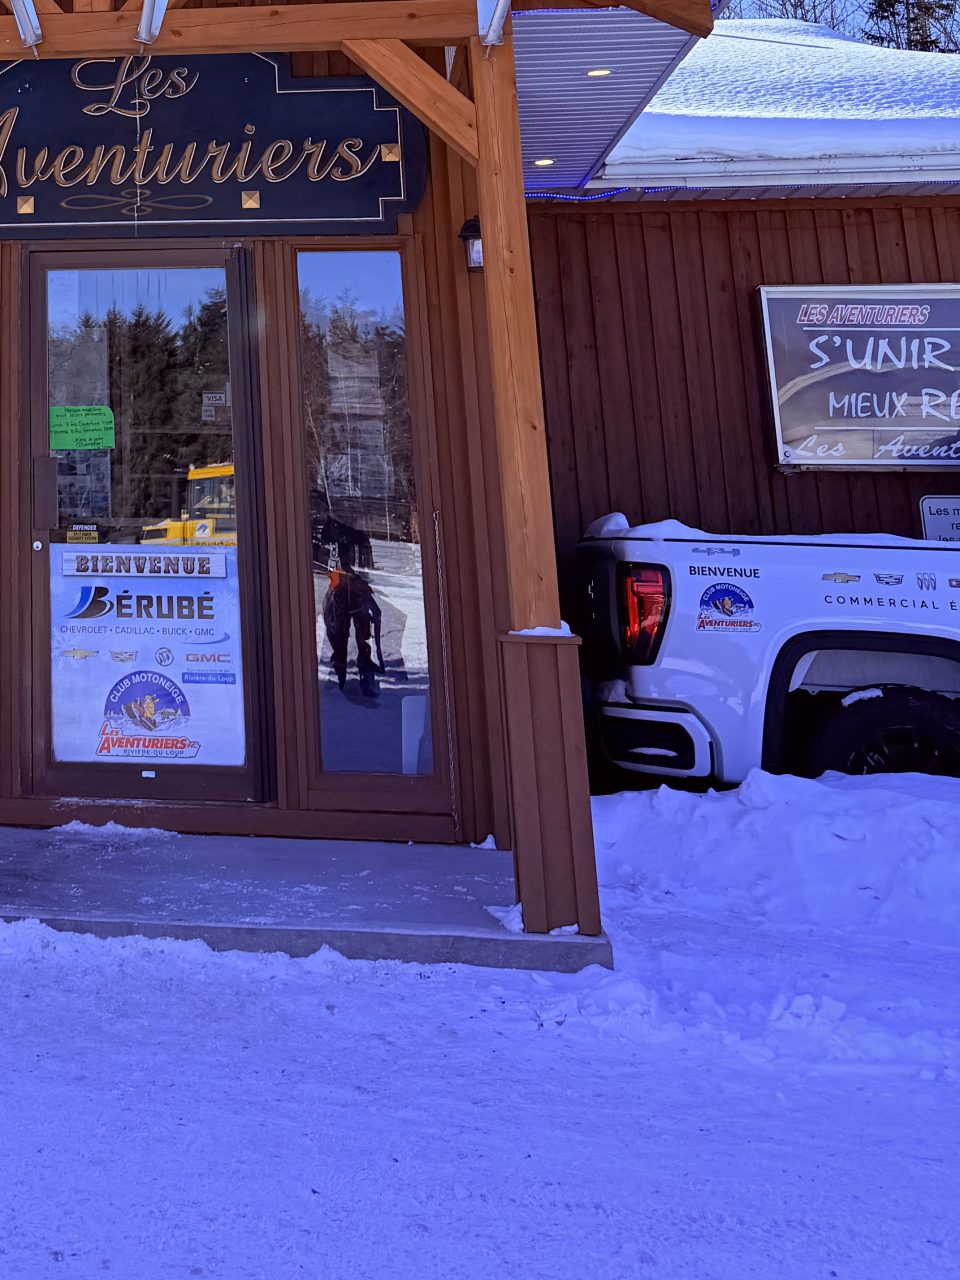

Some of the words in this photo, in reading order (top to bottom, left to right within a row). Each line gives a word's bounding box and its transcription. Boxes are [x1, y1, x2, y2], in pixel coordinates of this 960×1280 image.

[71, 55, 200, 118] Les
[797, 304, 828, 324] LES
[827, 304, 930, 325] AVENTURIERS
[808, 334, 955, 371] S'UNIR
[828, 391, 907, 419] MIEUX
[790, 434, 846, 457] Les
[928, 505, 950, 516] Les
[75, 555, 212, 575] BIENVENUE
[689, 566, 760, 578] BIENVENUE
[66, 586, 215, 620] BÉRUBÉ
[703, 587, 715, 601] CLUB
[824, 595, 939, 610] COMMERCIAL
[60, 625, 107, 634] CHEVROLET
[115, 626, 155, 635] CADILLAC
[194, 628, 215, 636] GMC
[698, 619, 753, 630] AVENTURIERS
[186, 653, 231, 663] GMC
[110, 679, 131, 703] CLUB
[132, 673, 184, 704] MOTONEIGE
[98, 736, 187, 754] AVENTURIERS
